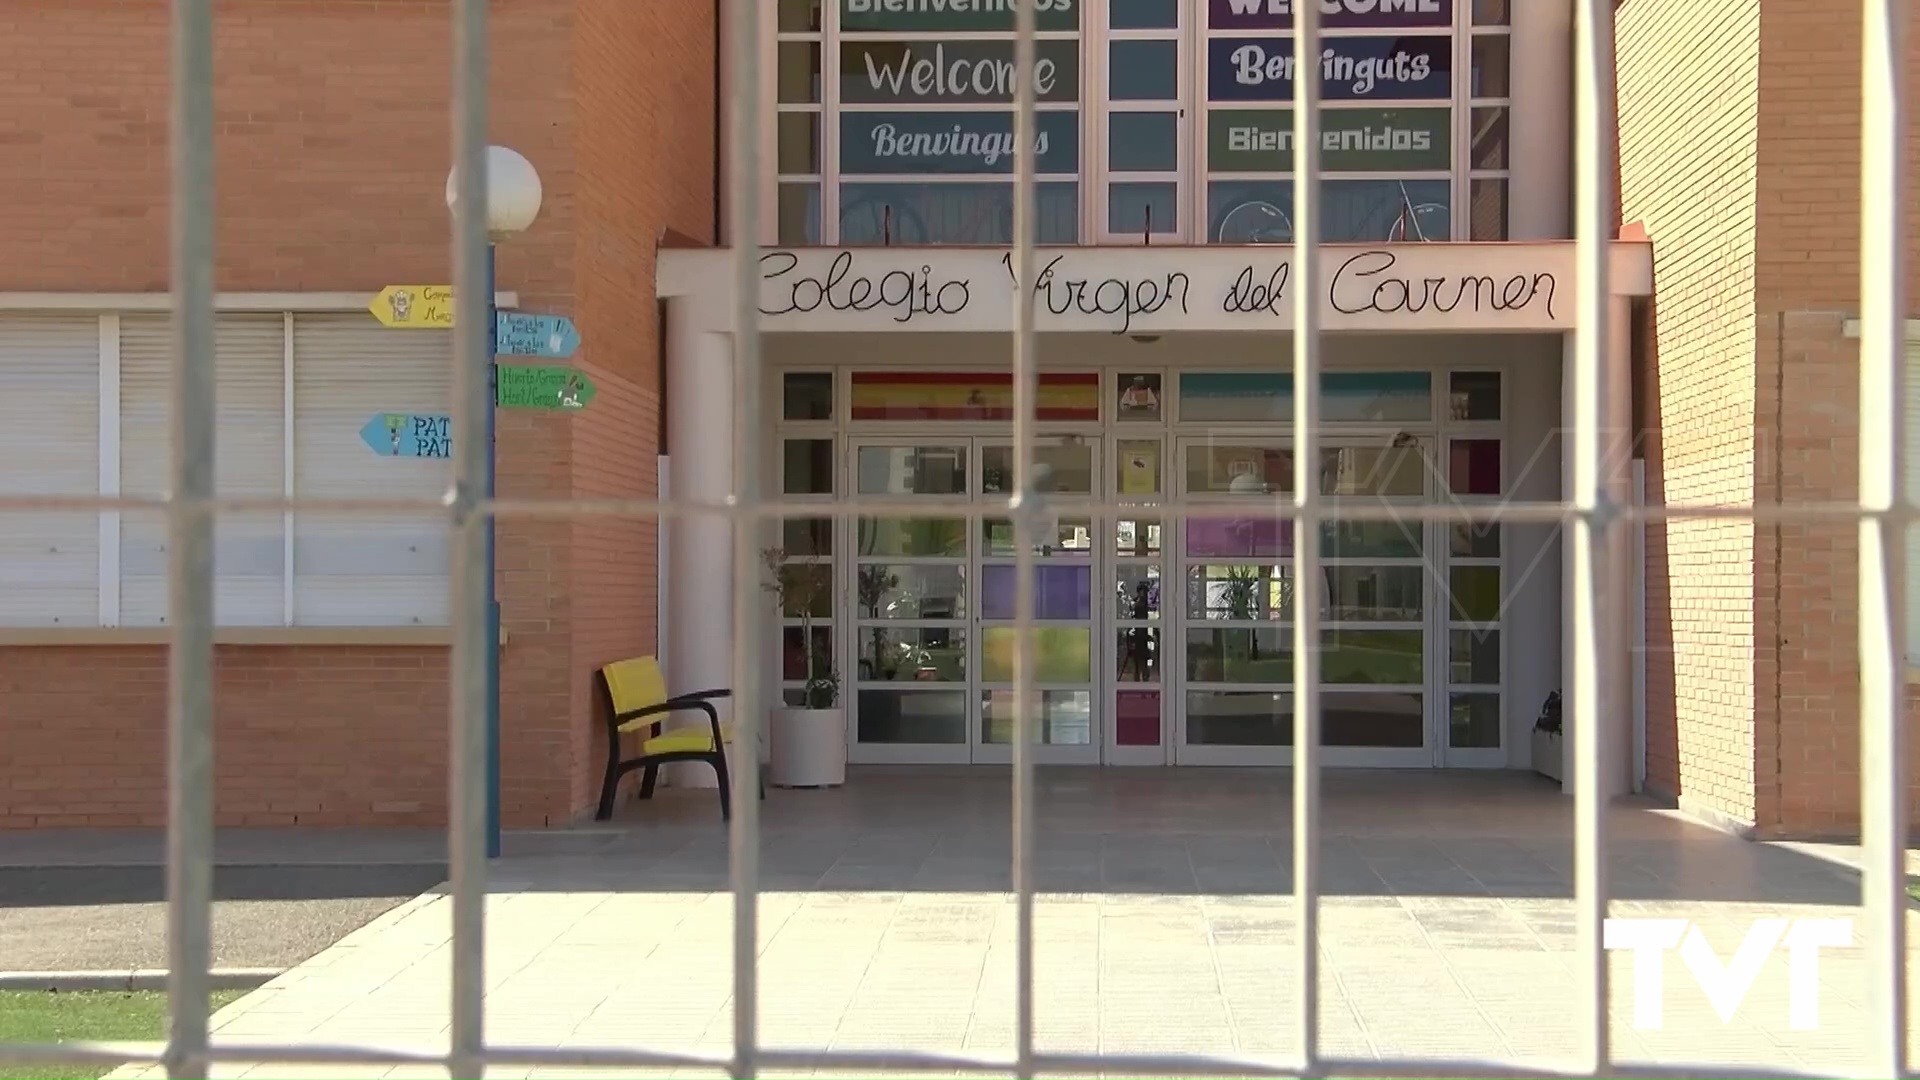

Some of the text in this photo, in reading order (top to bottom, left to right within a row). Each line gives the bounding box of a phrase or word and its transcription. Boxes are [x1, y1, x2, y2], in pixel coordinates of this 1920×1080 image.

[1228, 0, 1440, 15] WECOME
[1230, 45, 1430, 94] Beninguts
[871, 123, 1049, 165] Benvingus
[1228, 126, 1431, 151] Bienenidos
[758, 250, 1556, 335] Colegio Virgen del Carmen
[413, 416, 452, 437] PAT
[416, 437, 453, 458] PAT
